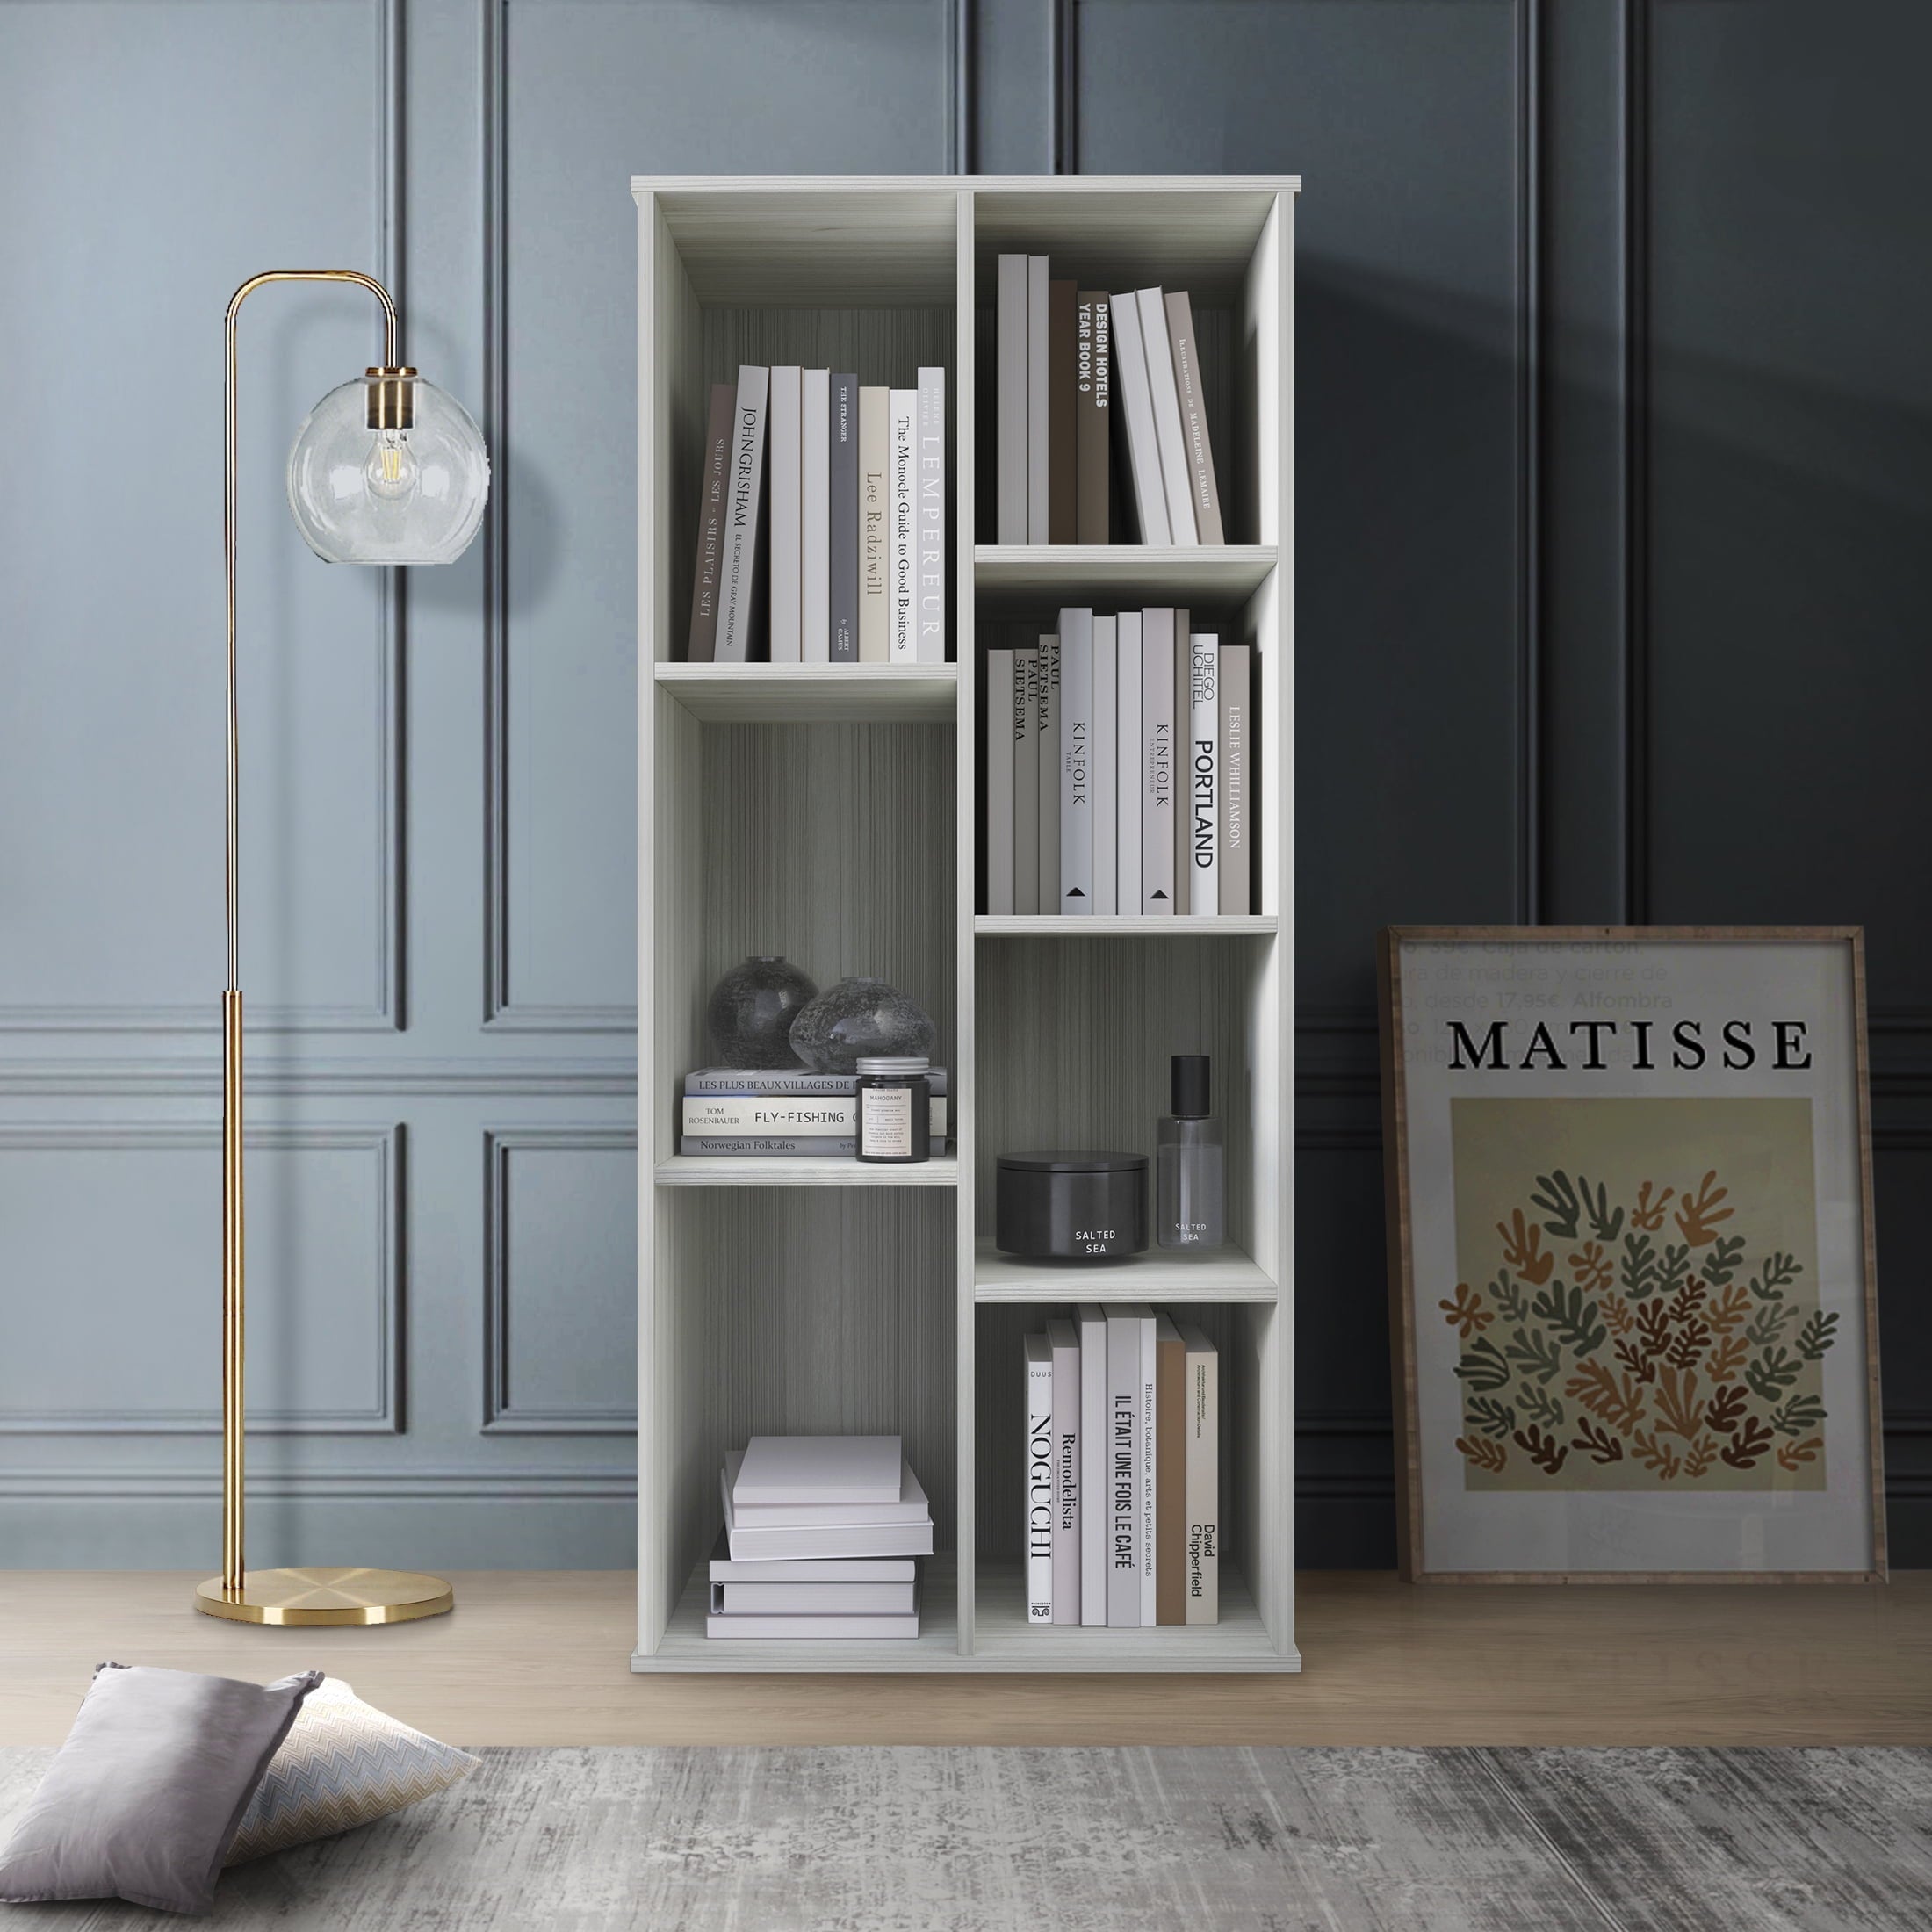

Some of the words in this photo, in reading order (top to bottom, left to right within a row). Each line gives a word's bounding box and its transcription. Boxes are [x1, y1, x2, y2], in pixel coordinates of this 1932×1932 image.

[1078, 303, 1091, 338] YEAR
[1096, 304, 1108, 353] DESIGN
[1078, 342, 1091, 379] BOOK
[1079, 384, 1091, 393] 9
[1096, 357, 1108, 408] HOTELS
[898, 416, 910, 442] The
[714, 438, 724, 476] JOURS
[898, 445, 910, 499] Monocle
[1189, 412, 1204, 465] MADELEINE
[1198, 469, 1210, 509] LEMAIRE
[711, 480, 721, 502] LES
[867, 472, 882, 503] Lee
[898, 501, 910, 540] Guide
[923, 435, 940, 636] LEMPEREUR
[703, 517, 717, 585] PLAISIRS
[732, 543, 742, 573] SECRETO
[867, 511, 882, 595] Radziwill
[898, 544, 908, 556] to
[732, 575, 739, 584] DE
[898, 559, 910, 593] Good
[700, 590, 710, 616] LES
[726, 606, 735, 646] MOUNTAIN
[898, 597, 910, 650] Business
[1028, 660, 1038, 702] PAUL
[1051, 645, 1060, 690] PAUL
[1193, 645, 1204, 710] UCHITEL
[1204, 652, 1215, 701] DIEGO
[1016, 659, 1026, 741] SIETSEMA
[1040, 644, 1049, 732] SIETSEMA
[1229, 706, 1241, 748] LESLIE
[1073, 722, 1085, 804] KINFOLK
[1157, 724, 1169, 806] KINFOLK
[1195, 740, 1214, 869] PORTLAND
[1229, 753, 1241, 849] WHILLIAMSON
[1572, 991, 1673, 1008] Alfombra
[1447, 1020, 1813, 1071] MATISSE
[699, 1080, 717, 1091] LES
[719, 1080, 745, 1091] PLUS
[747, 1080, 782, 1091] BEAUX
[783, 1080, 833, 1091] VILLAGES
[835, 1080, 850, 1091] DE
[754, 1112, 844, 1123] FLY-FISHING
[700, 1140, 751, 1152] Norwegian
[753, 1140, 796, 1150] Folktales
[1075, 1230, 1116, 1240] SALTED
[1085, 1244, 1107, 1253] SEA
[1115, 1395, 1132, 1409] IL
[1115, 1412, 1135, 1449] ÉTAIT
[1115, 1453, 1132, 1479] UNE
[1143, 1426, 1152, 1475] botanique,
[1030, 1414, 1052, 1559] NOGUCHI
[1062, 1432, 1077, 1531] Remodelista
[1115, 1482, 1132, 1511] FOIS
[1115, 1515, 1132, 1530] LE
[1144, 1501, 1152, 1510] et
[1143, 1512, 1152, 1539] petits
[1204, 1524, 1215, 1557] David
[1115, 1533, 1135, 1568] CAFÉ
[1188, 1524, 1204, 1597] Chipperfield
